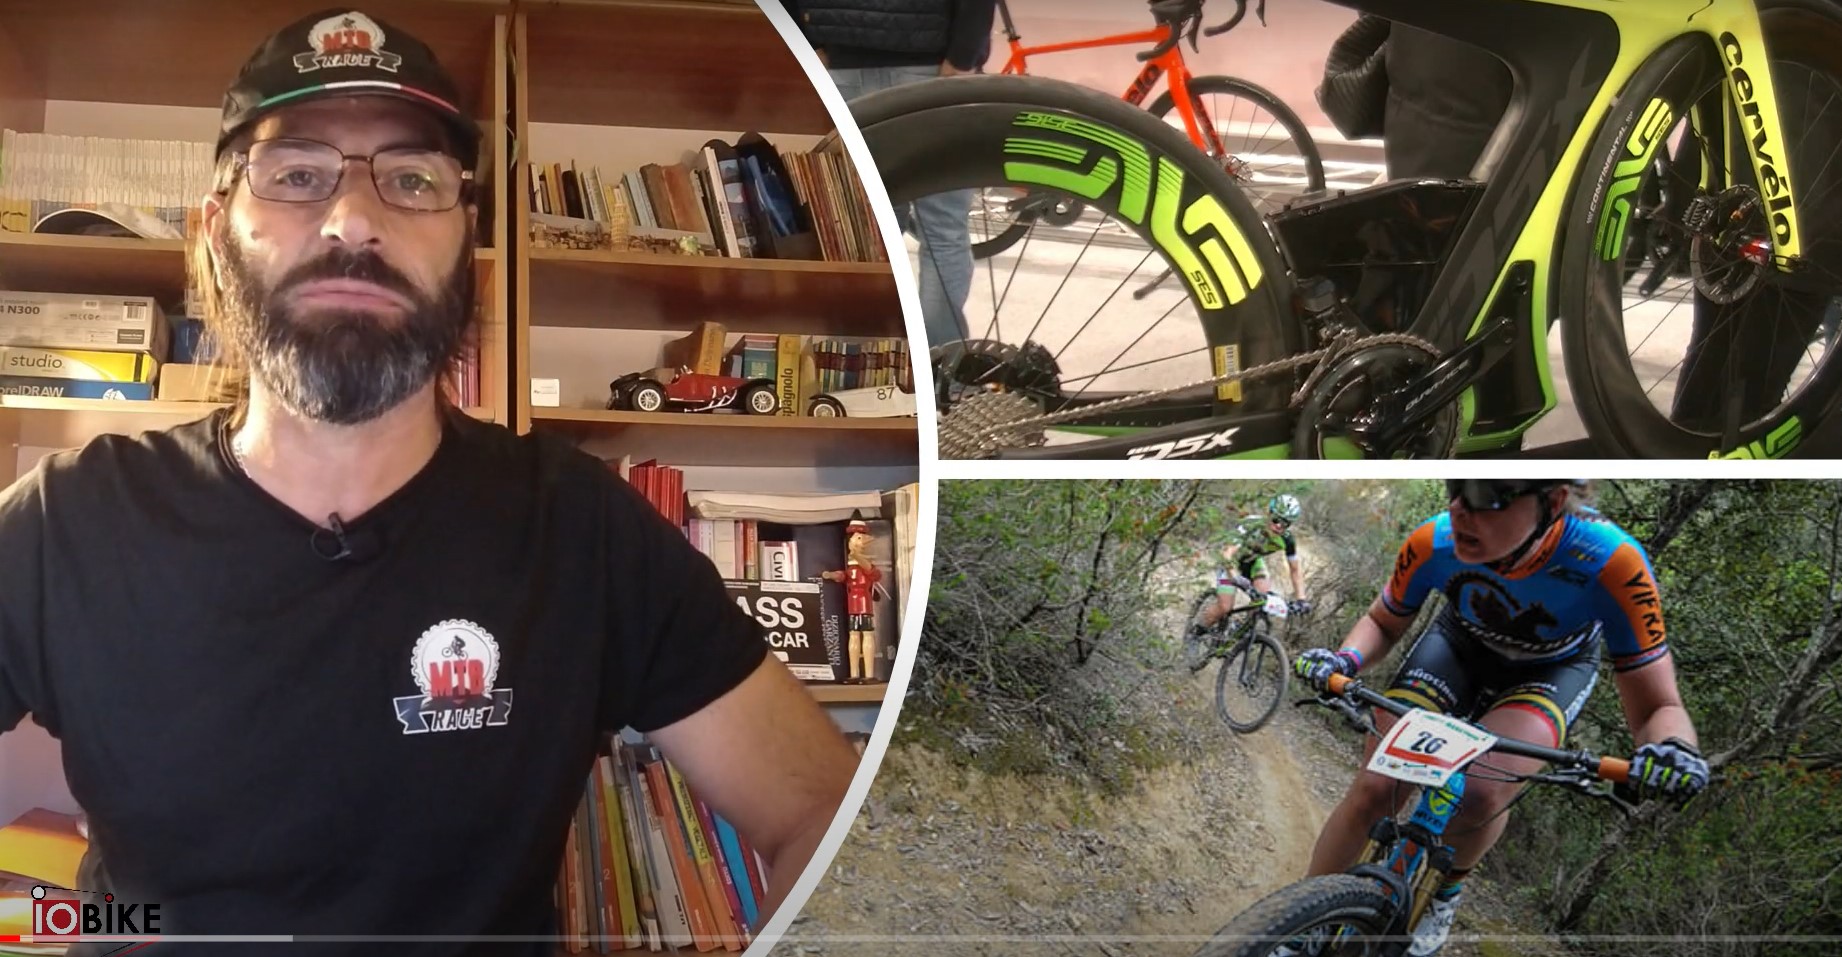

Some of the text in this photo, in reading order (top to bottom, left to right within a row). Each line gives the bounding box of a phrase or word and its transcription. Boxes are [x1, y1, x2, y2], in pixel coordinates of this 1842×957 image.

[323, 29, 371, 51] MTB
[322, 54, 371, 68] RACE
[1588, 125, 1628, 211] CONTINENTAL
[1190, 269, 1218, 305] SES
[7, 304, 41, 315] N300
[10, 353, 63, 370] studio
[876, 387, 895, 401] 87
[428, 658, 486, 699] MTB
[431, 706, 487, 732] RACE
[1410, 730, 1448, 754] 26
